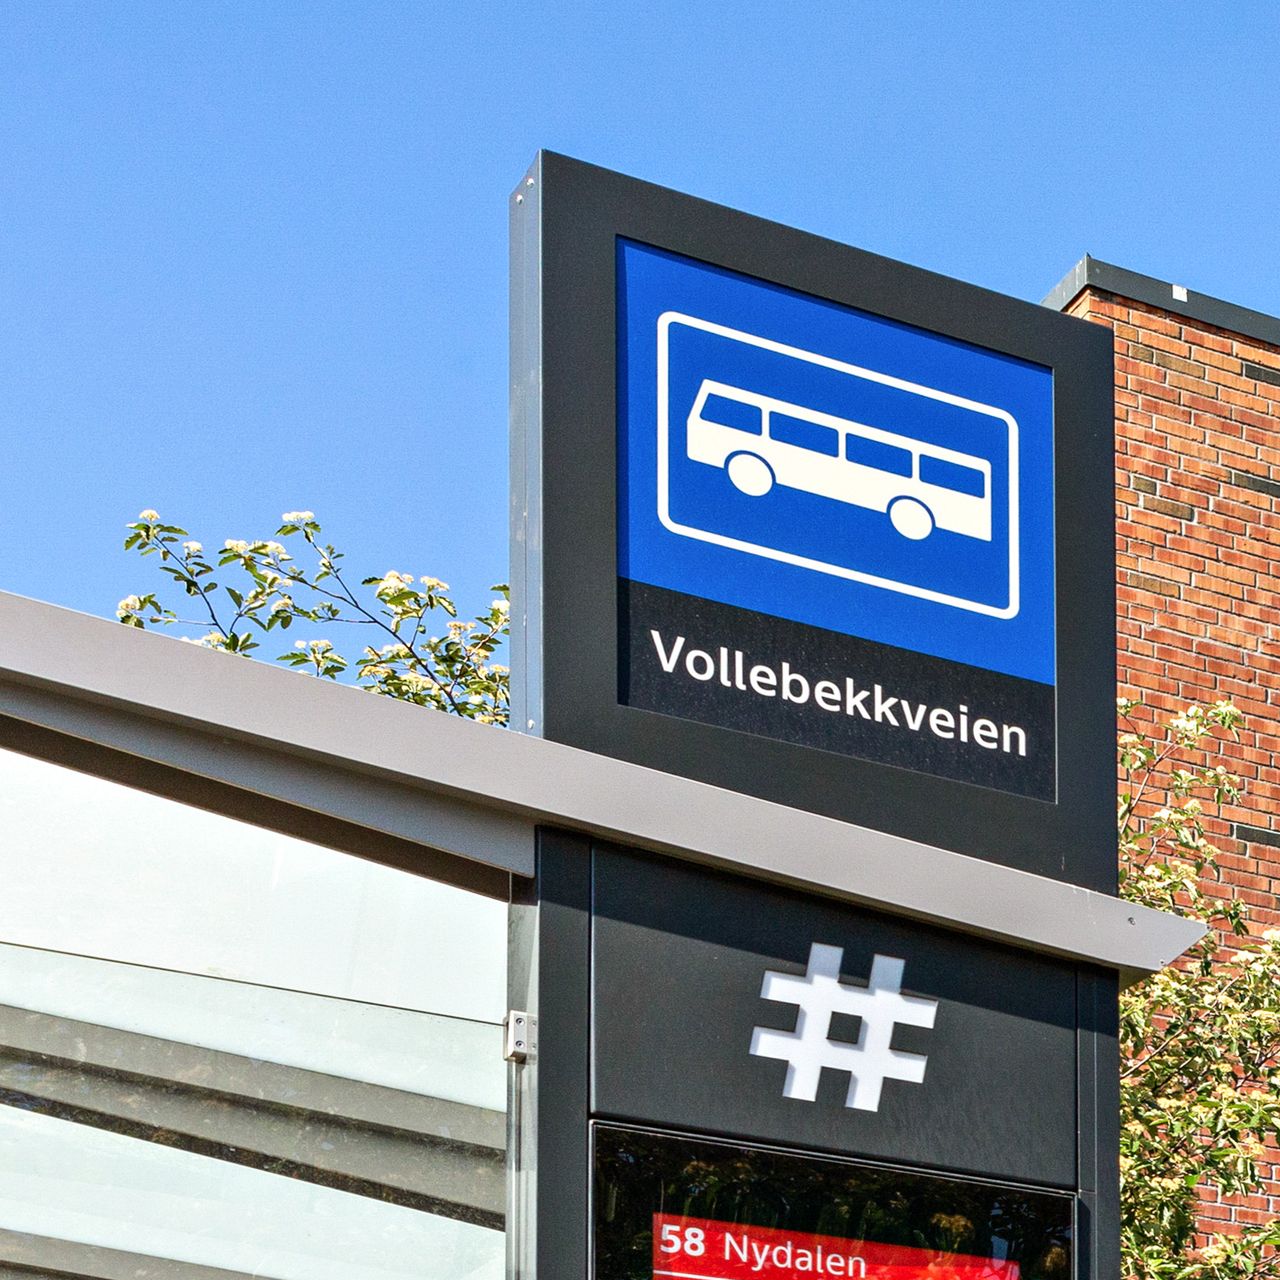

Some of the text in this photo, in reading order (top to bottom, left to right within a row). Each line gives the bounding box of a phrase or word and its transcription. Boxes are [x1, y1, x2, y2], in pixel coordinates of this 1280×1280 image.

[651, 629, 1027, 757] Vollebekkveien
[660, 1223, 866, 1278] 58 Nydalen
